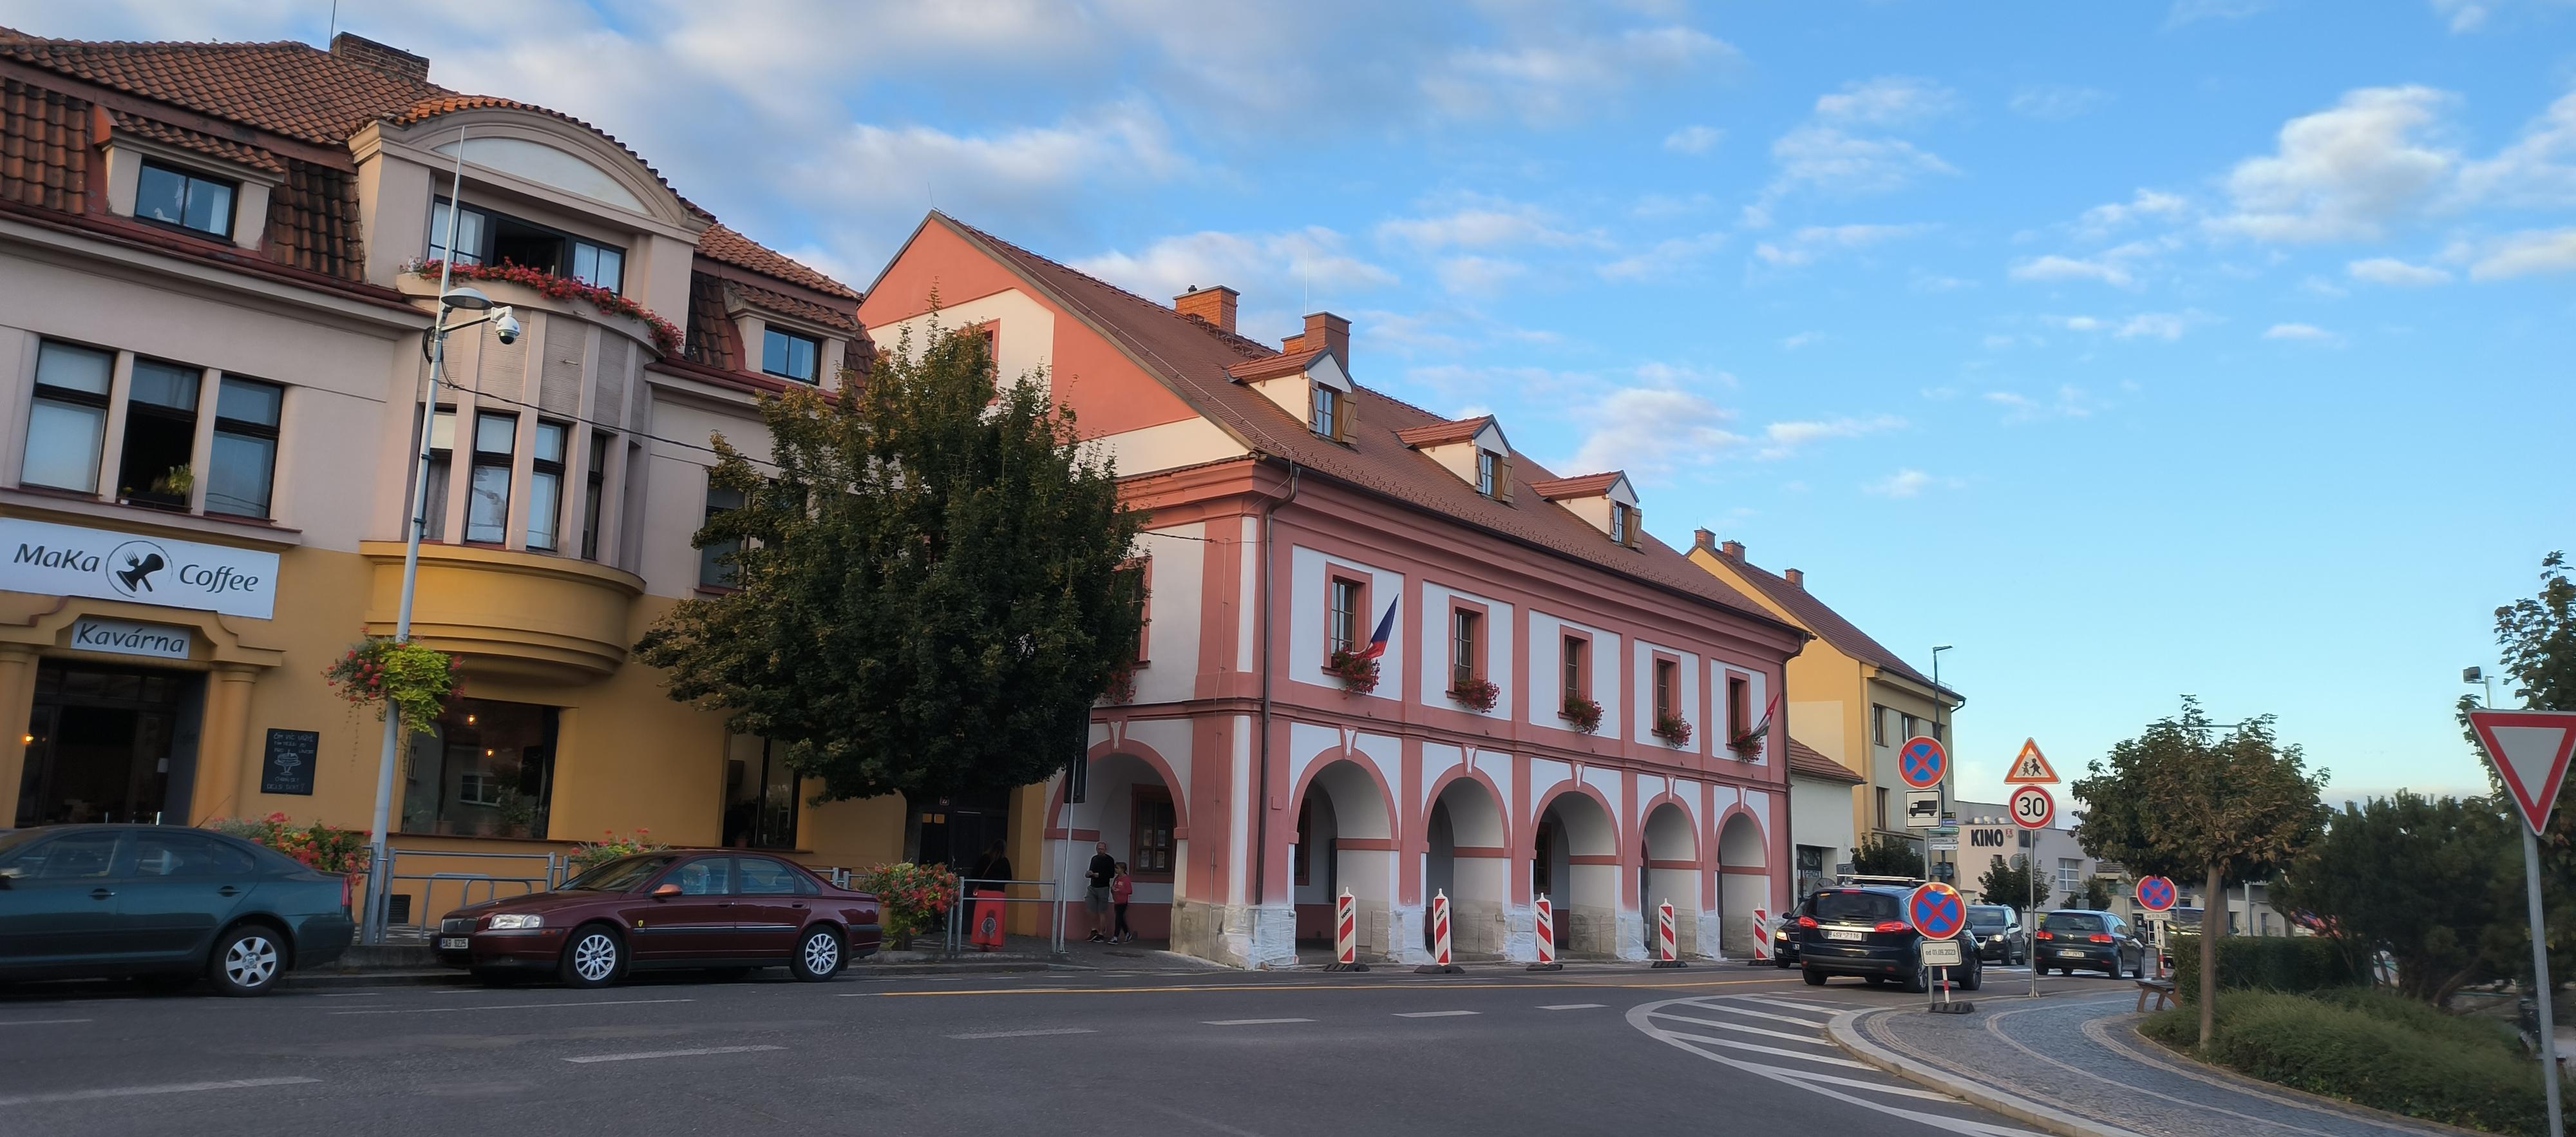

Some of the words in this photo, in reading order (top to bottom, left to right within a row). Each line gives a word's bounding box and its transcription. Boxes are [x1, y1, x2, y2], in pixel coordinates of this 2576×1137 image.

[14, 543, 100, 572] MaKa
[179, 564, 259, 593] Coffee
[77, 622, 185, 653] Kavárna
[2020, 797, 2045, 817] 30
[1971, 828, 2004, 846] KINO
